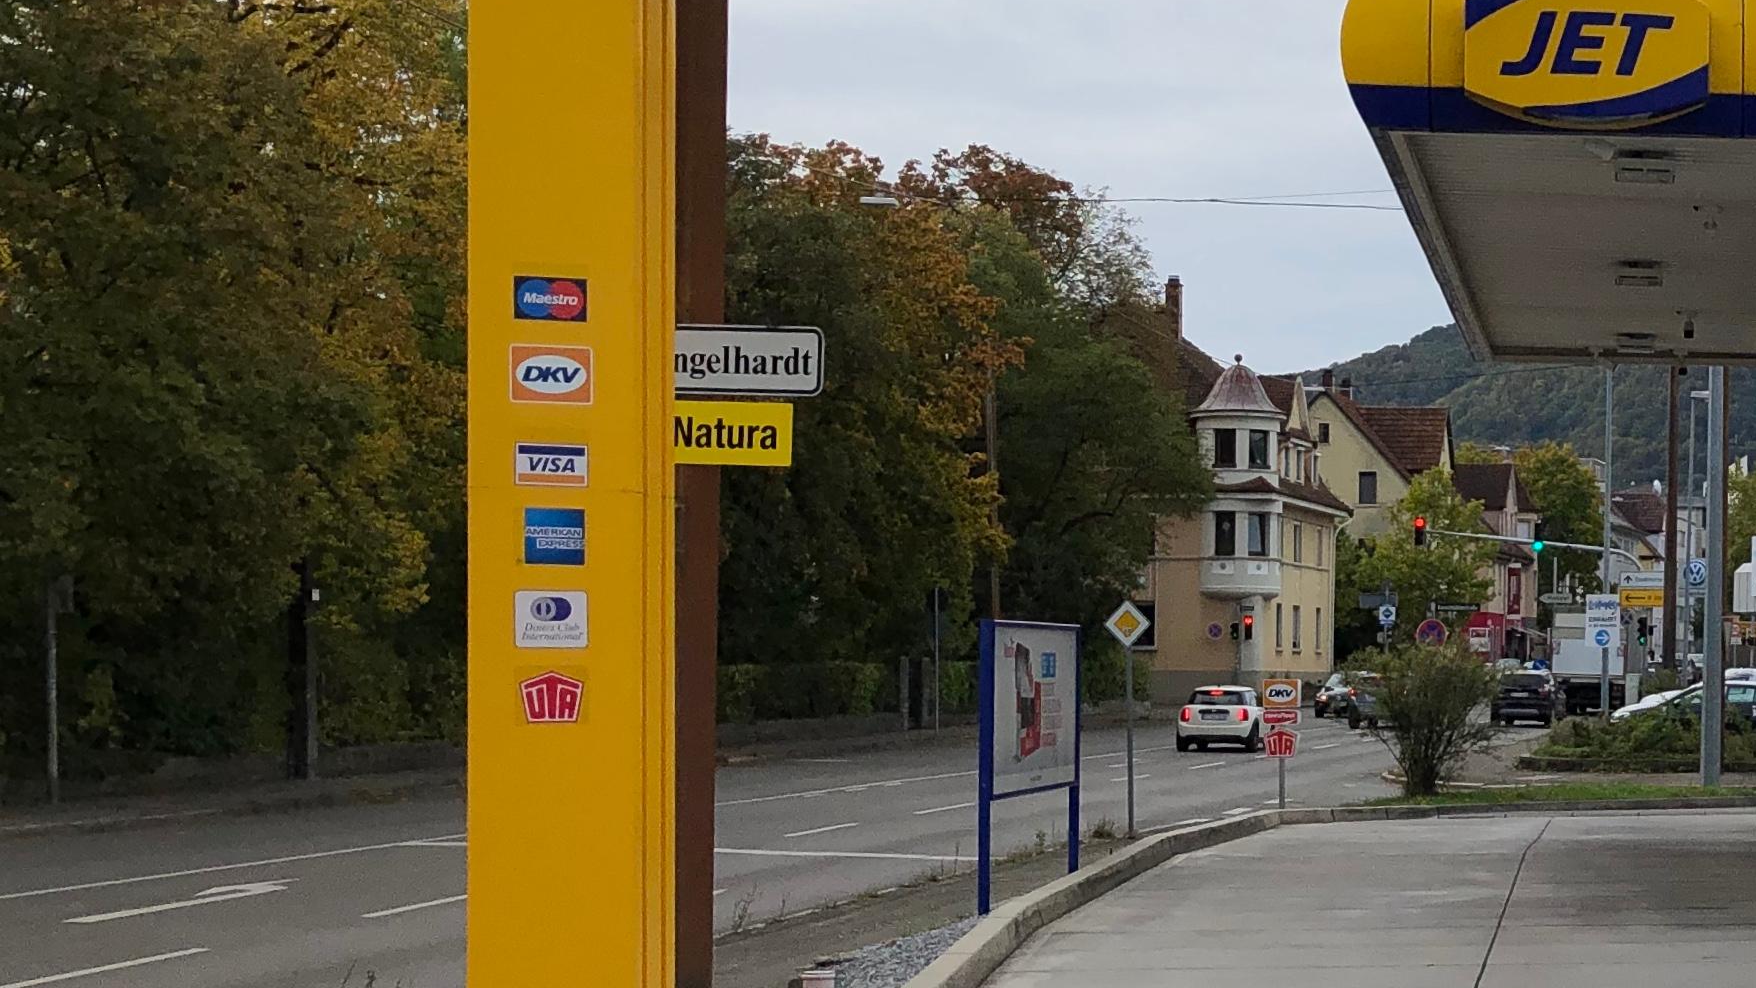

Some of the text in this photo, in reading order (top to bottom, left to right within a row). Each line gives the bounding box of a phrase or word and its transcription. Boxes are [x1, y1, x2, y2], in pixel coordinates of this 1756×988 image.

[1499, 10, 1675, 77] JET
[523, 292, 579, 305] Maestro
[674, 345, 813, 379] ngelhardt
[522, 365, 581, 383] DKV
[673, 415, 778, 450] Natura
[527, 456, 576, 473] VISA
[525, 527, 582, 537] AMERICAN
[524, 675, 579, 720] UTA
[1268, 688, 1294, 698] DKV
